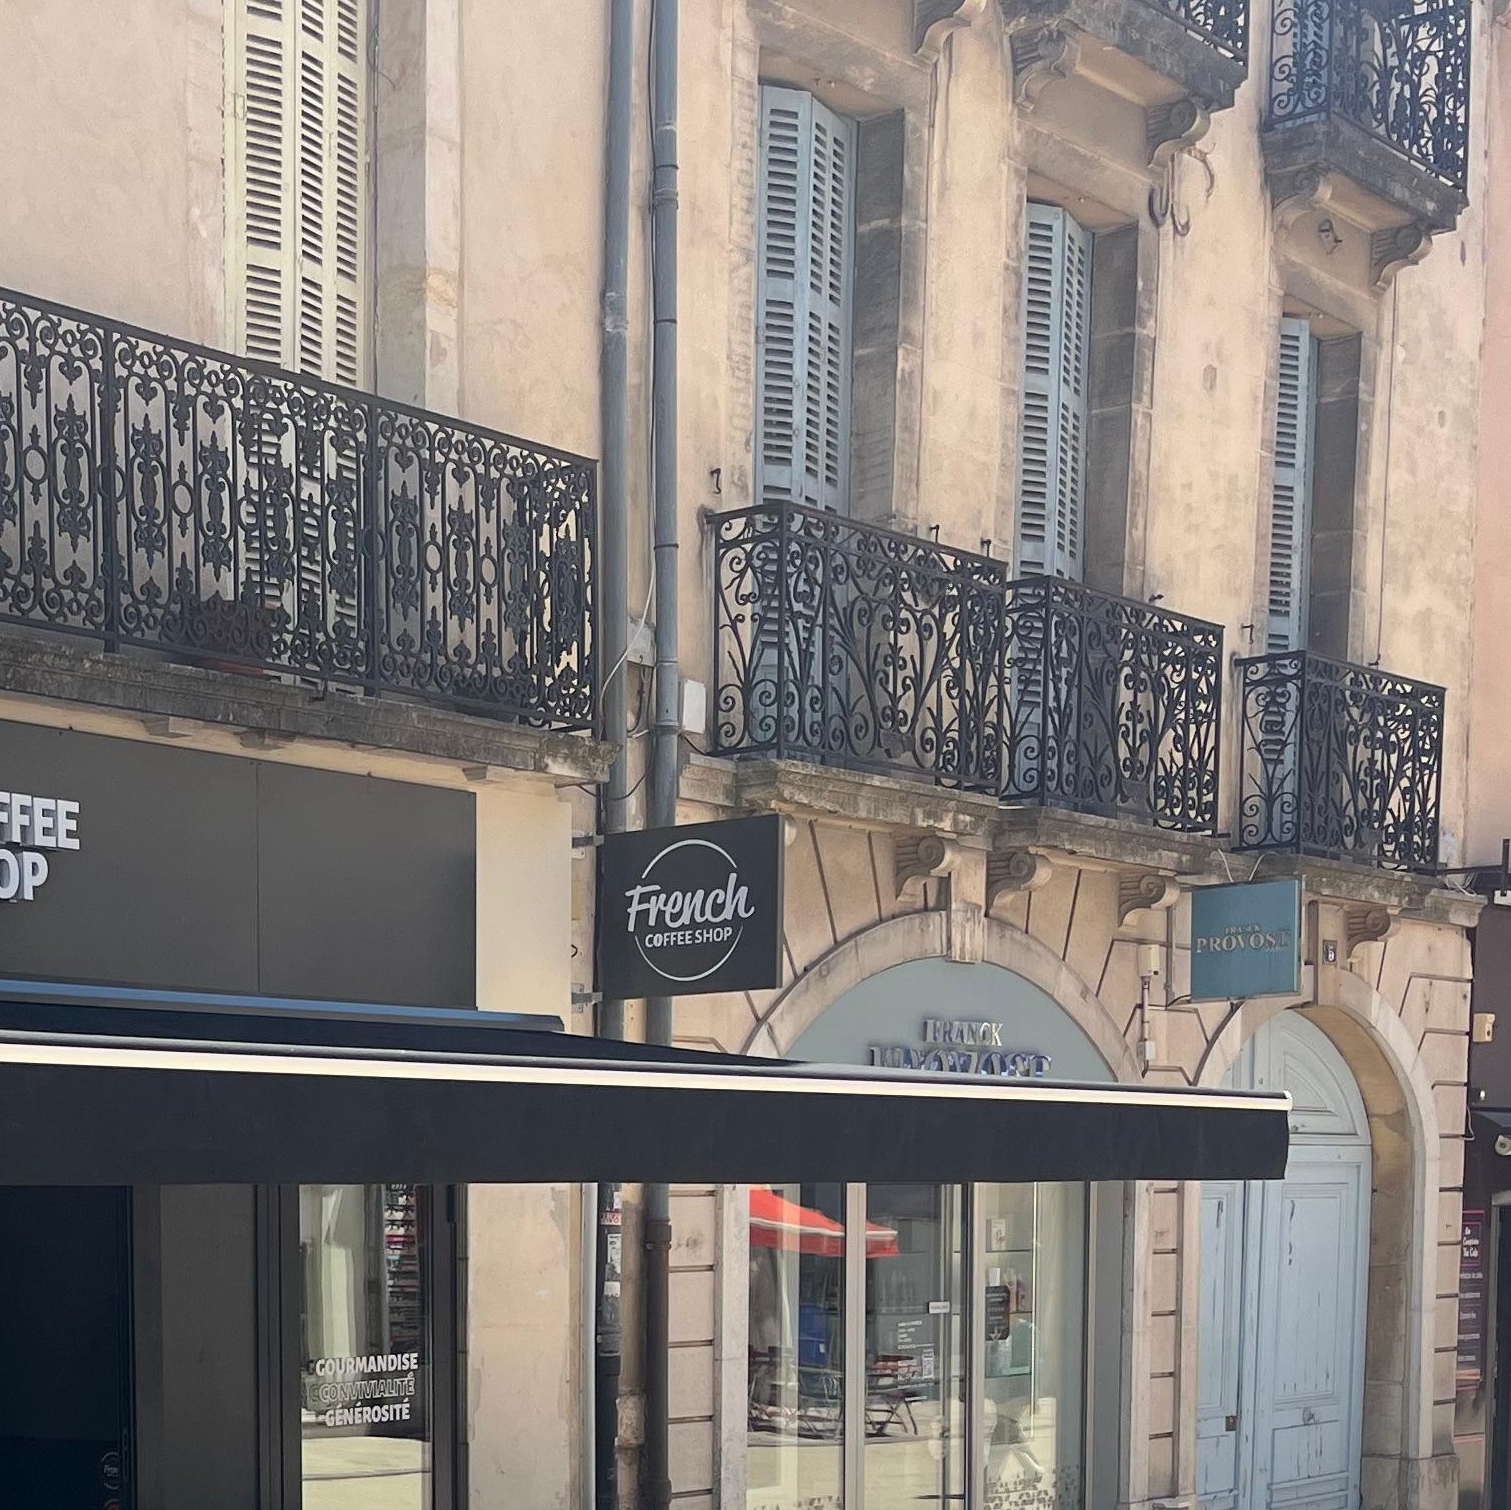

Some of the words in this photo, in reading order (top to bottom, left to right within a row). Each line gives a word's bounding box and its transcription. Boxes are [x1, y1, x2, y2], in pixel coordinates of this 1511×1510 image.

[625, 873, 755, 932] French
[645, 930, 692, 948] COFFEE
[695, 927, 733, 944] SHOP
[1196, 930, 1291, 953] PROVOST
[924, 1019, 1003, 1047] FRANCK
[316, 1352, 418, 1376] GOURMANDISE
[319, 1371, 415, 1402] CONVIVIALITÉ
[325, 1397, 410, 1427] GÉNÉROSITÉ
